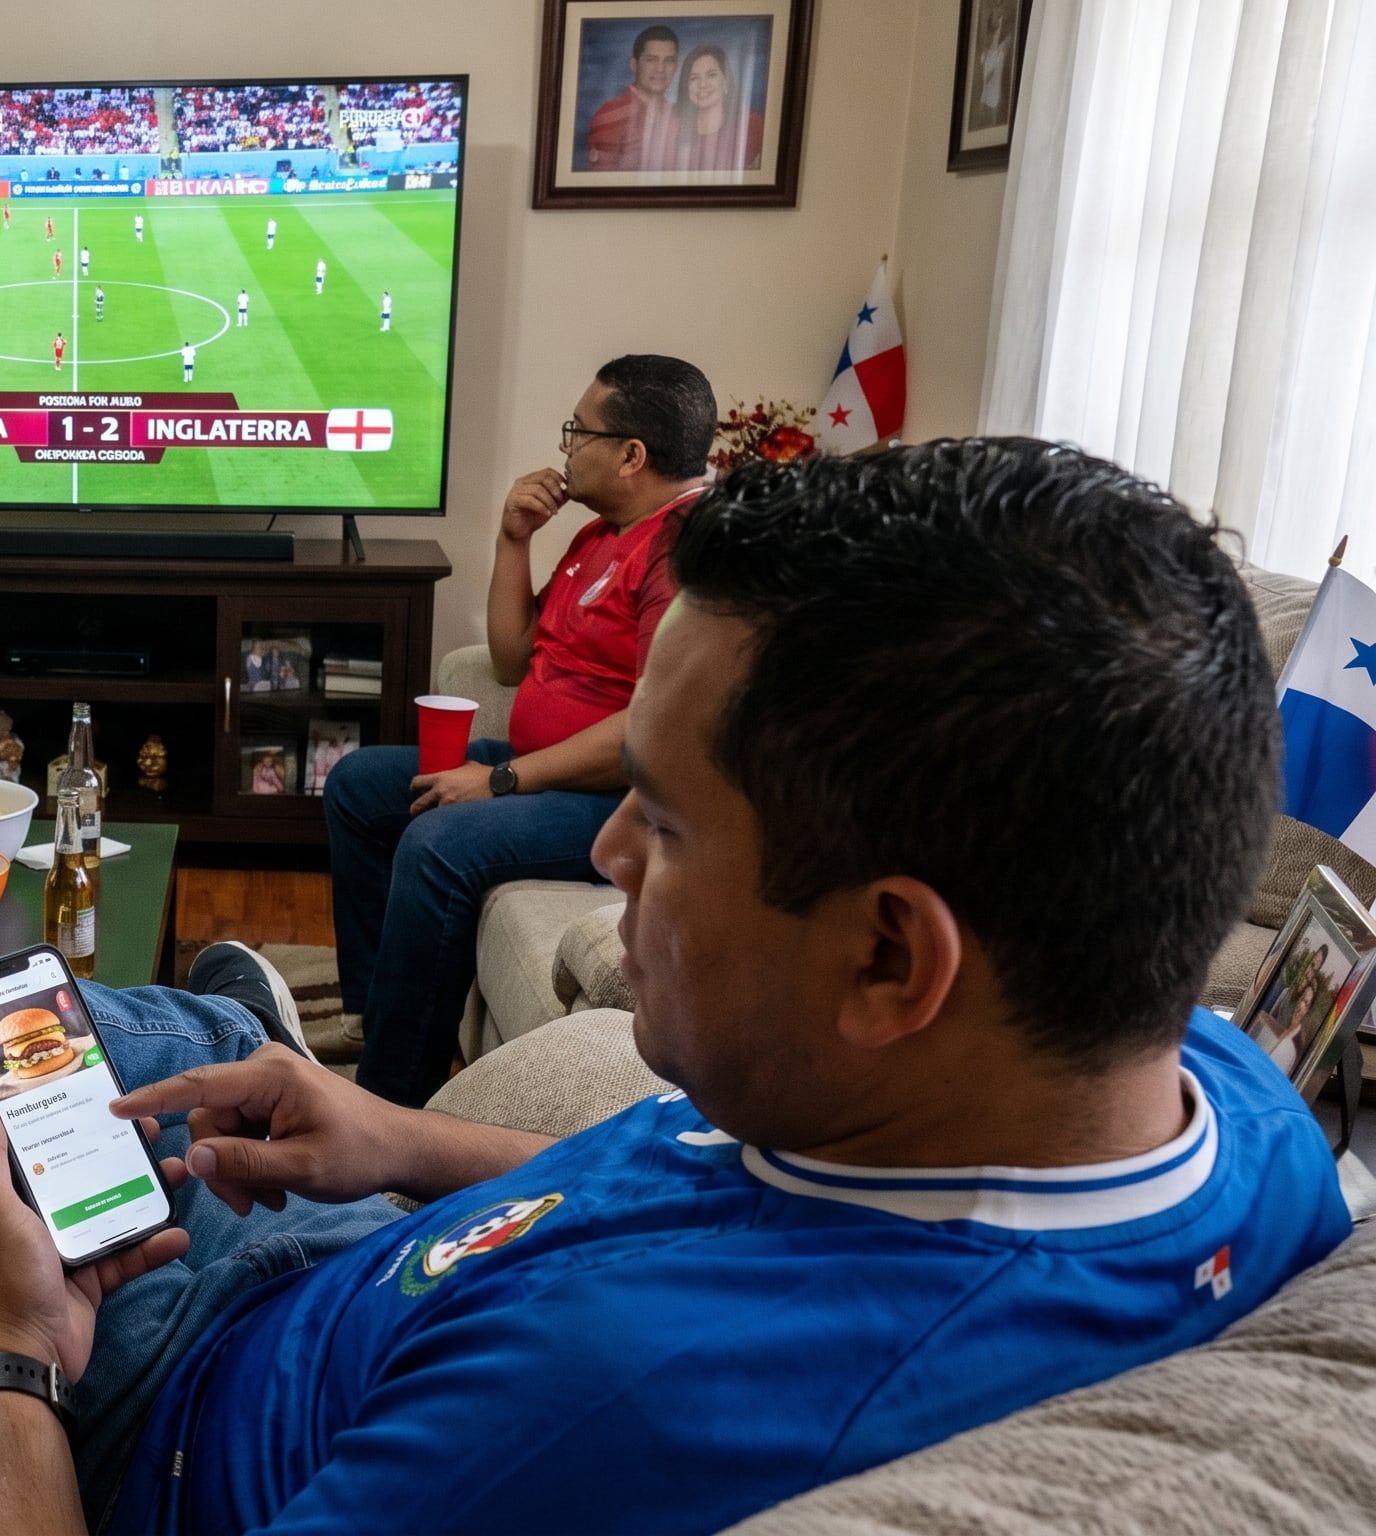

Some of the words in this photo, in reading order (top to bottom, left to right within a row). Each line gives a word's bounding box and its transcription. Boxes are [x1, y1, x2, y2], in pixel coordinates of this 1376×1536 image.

[61, 416, 73, 441] 1
[100, 416, 120, 441] 2
[147, 418, 312, 442] INGLATERRA
[6, 1091, 67, 1120] Hamburguesa
